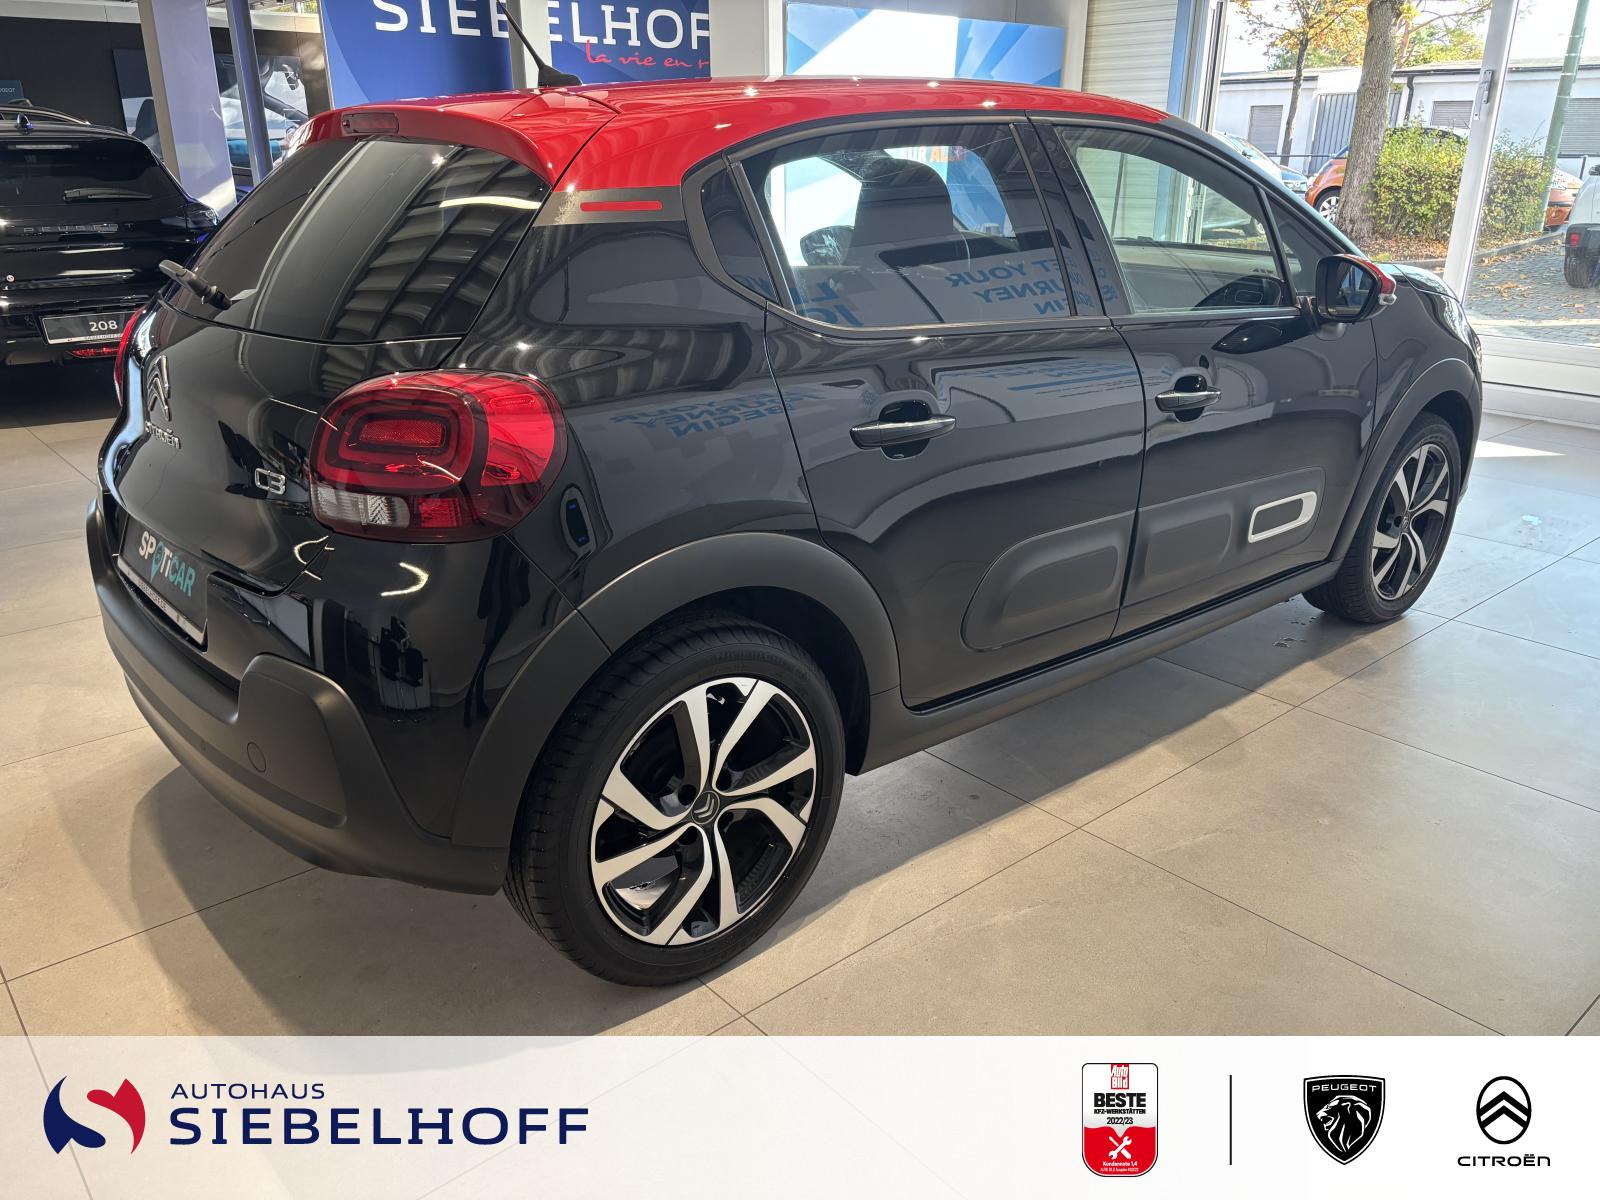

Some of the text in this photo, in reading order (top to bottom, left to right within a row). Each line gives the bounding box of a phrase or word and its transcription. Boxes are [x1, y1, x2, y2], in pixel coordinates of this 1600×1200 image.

[586, 40, 612, 63] la
[619, 52, 656, 66] vie
[664, 57, 693, 67] en
[89, 320, 118, 332] 208
[255, 467, 287, 495] C3
